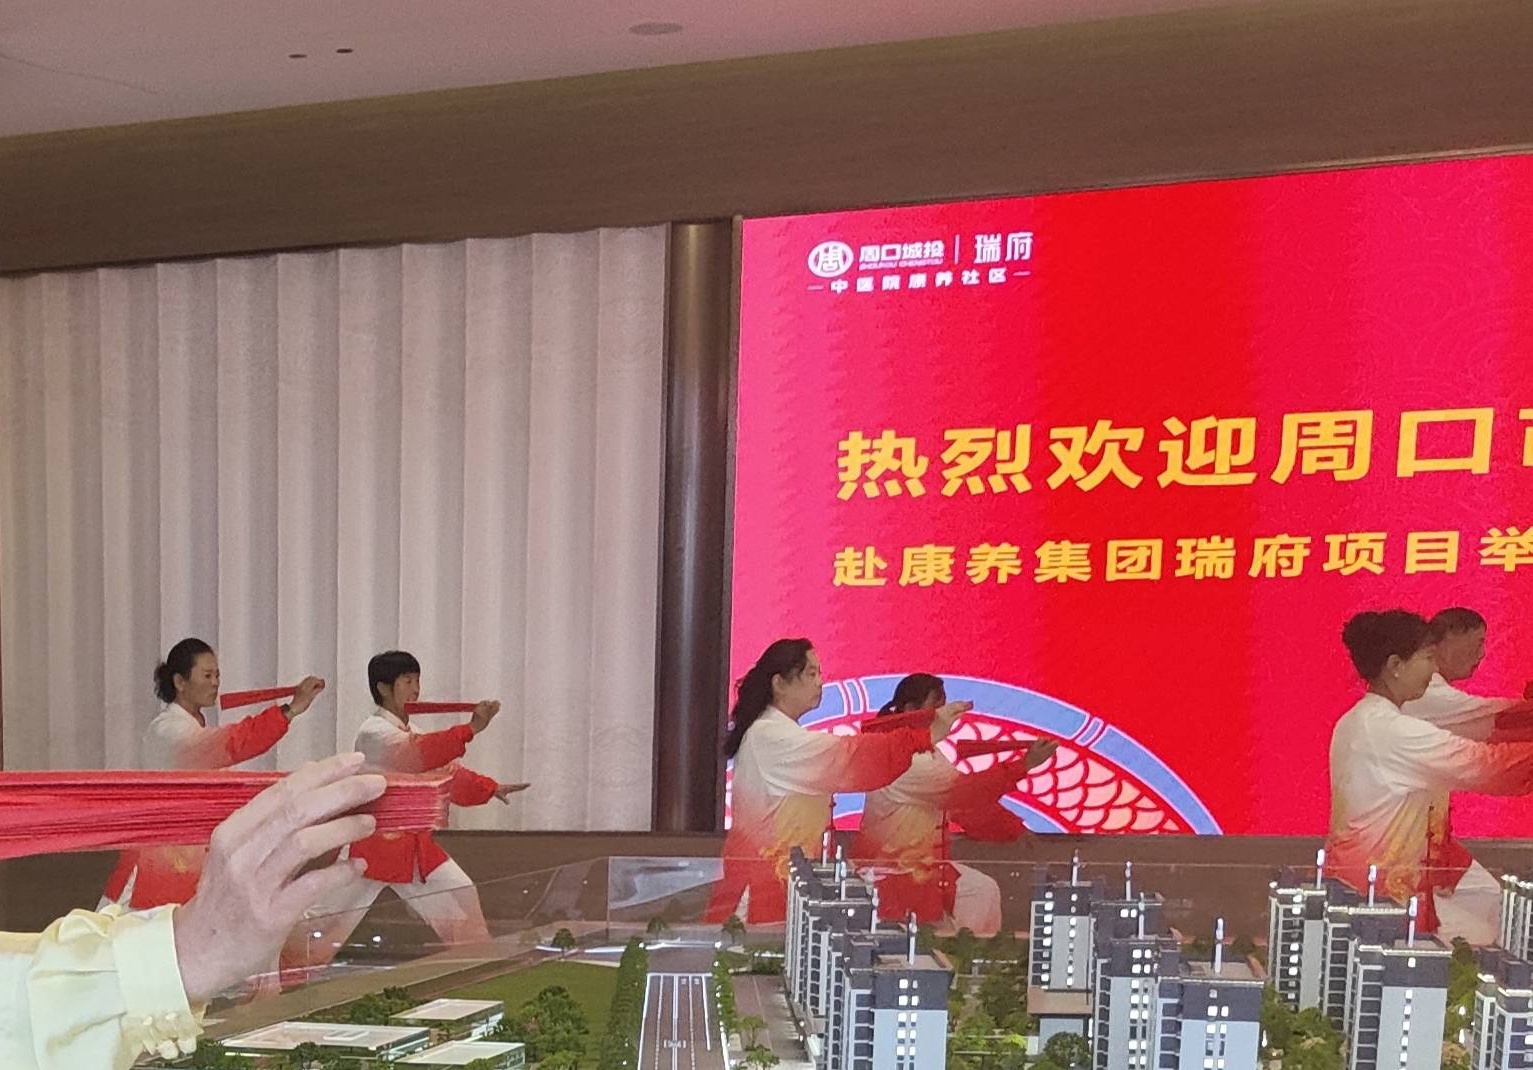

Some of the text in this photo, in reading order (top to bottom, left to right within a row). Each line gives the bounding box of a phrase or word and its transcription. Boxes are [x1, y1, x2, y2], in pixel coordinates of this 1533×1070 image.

[858, 232, 1034, 264] 周口城投 瑞府
[830, 267, 1007, 294] 中医院康养社区
[837, 407, 1533, 500] 热烈欢迎周口
[833, 526, 1533, 587] 赴康养集团瑞府项目举
